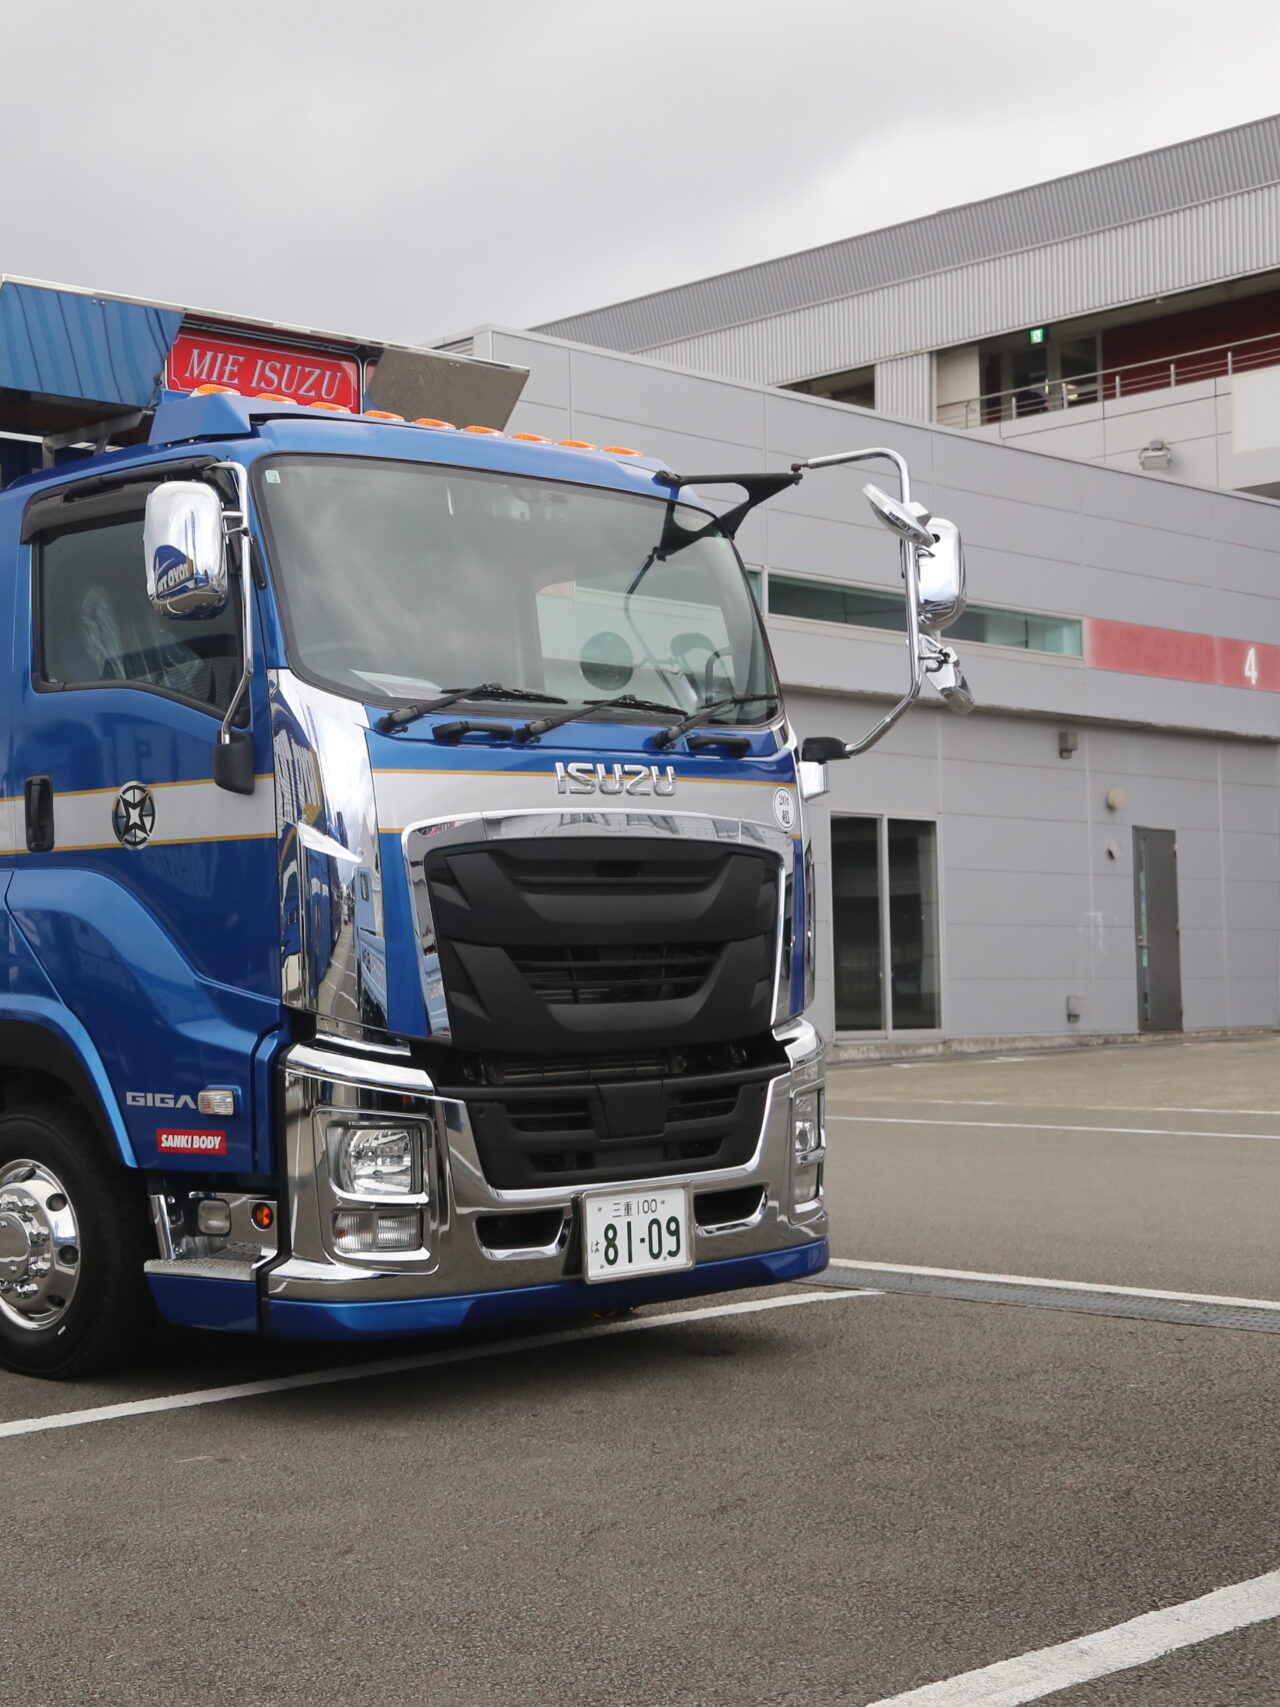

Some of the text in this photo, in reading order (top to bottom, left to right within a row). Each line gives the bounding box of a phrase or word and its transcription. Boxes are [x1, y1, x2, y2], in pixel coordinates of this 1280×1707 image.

[185, 348, 342, 400] MIE ISUZU
[1244, 647, 1258, 686] 4
[555, 761, 677, 797] ISUZU
[126, 1091, 198, 1109] GIGA
[160, 1133, 222, 1150] SANKI BODY
[636, 1198, 658, 1216] 100
[603, 1215, 681, 1267] 81-09
